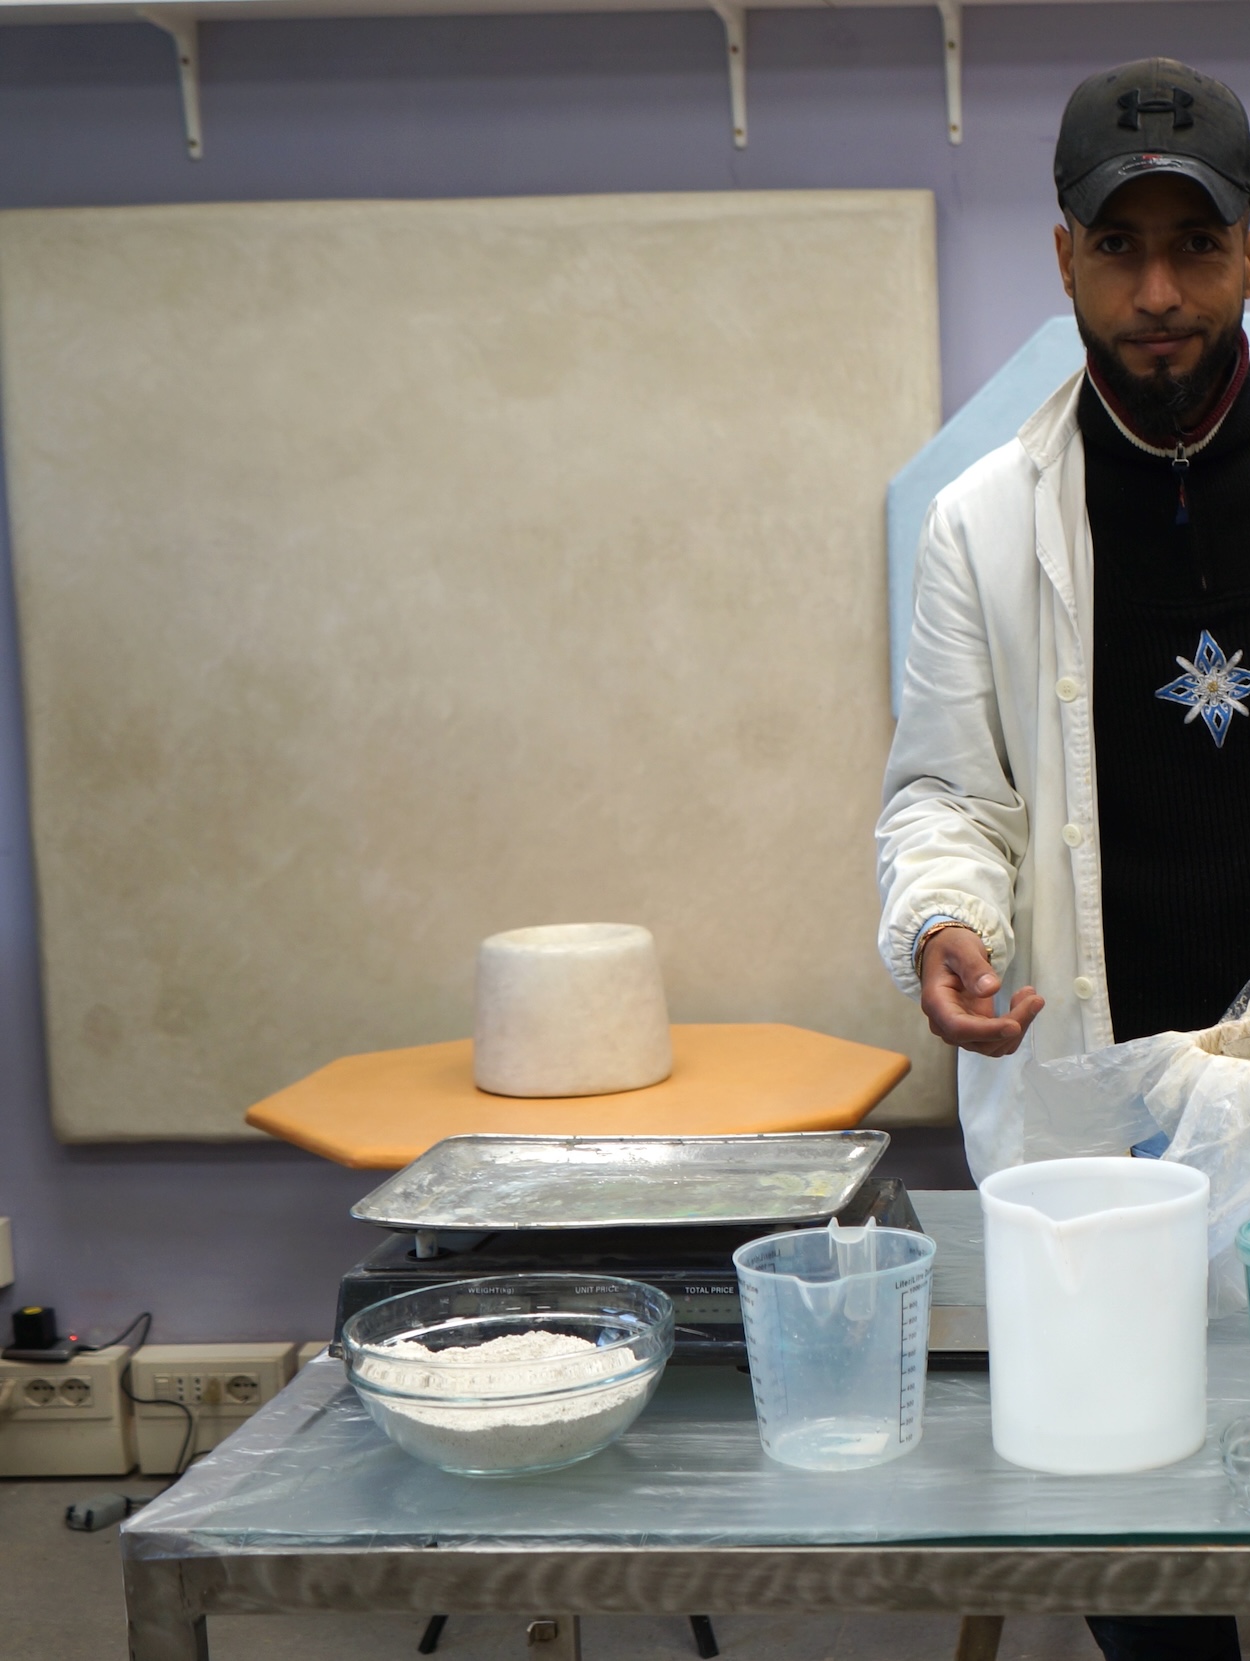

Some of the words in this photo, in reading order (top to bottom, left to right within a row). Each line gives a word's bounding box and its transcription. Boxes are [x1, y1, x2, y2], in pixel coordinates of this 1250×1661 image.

[468, 1287, 515, 1295] WEIGHT(kg)
[575, 1286, 594, 1295] UNIT
[596, 1285, 619, 1293] PRICE
